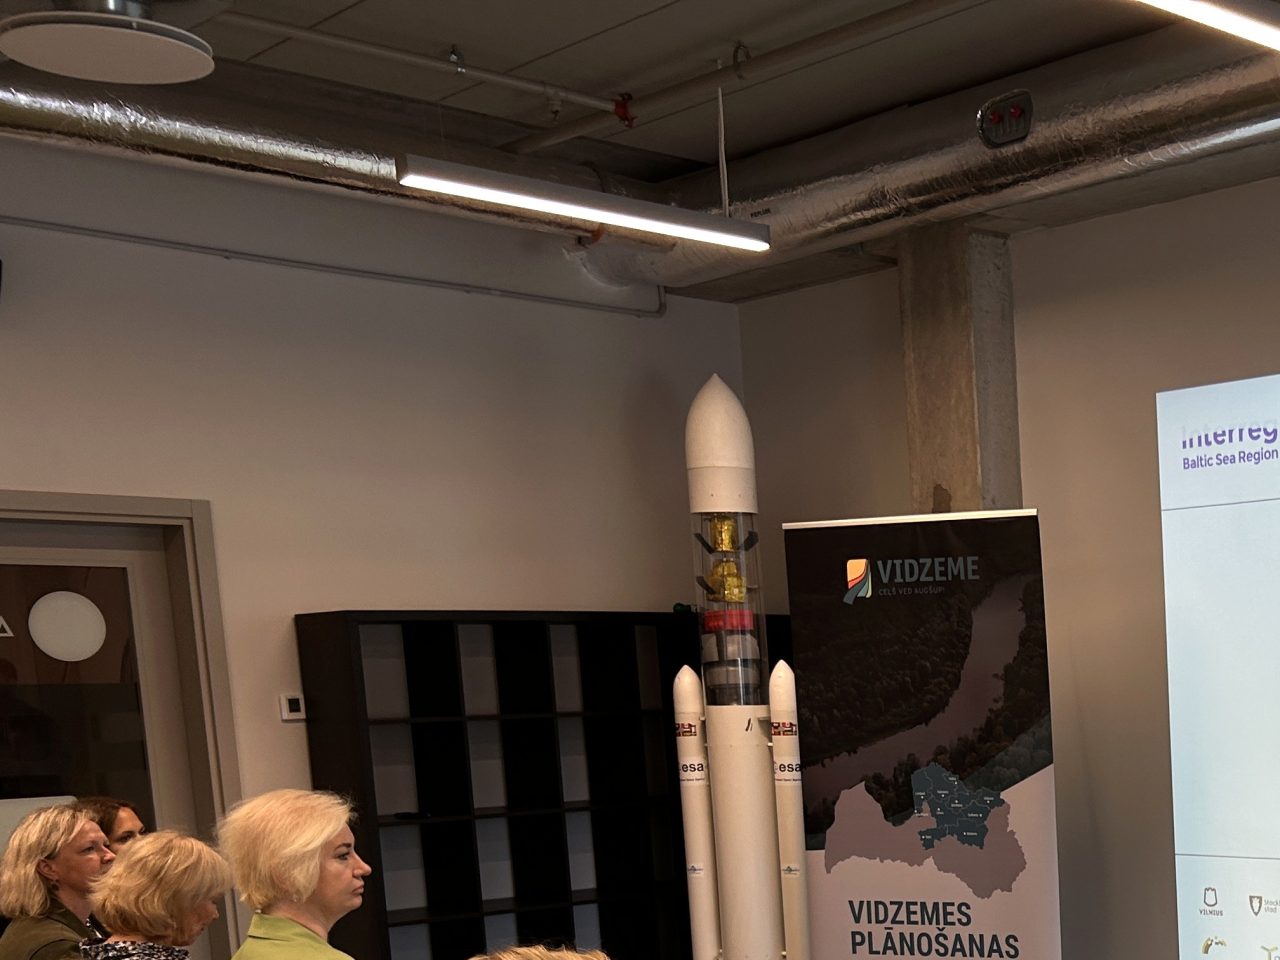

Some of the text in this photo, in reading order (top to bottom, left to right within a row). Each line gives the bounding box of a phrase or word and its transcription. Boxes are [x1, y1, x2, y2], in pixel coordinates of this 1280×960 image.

[1183, 447, 1279, 470] Baltic Sea Region
[876, 556, 980, 584] VIDZEME
[681, 762, 704, 773] esa
[778, 762, 801, 773] esa
[848, 900, 972, 927] VIDZEMES
[1198, 908, 1224, 917] VILNIUS
[851, 926, 1020, 959] PLĀNOŠANAS
